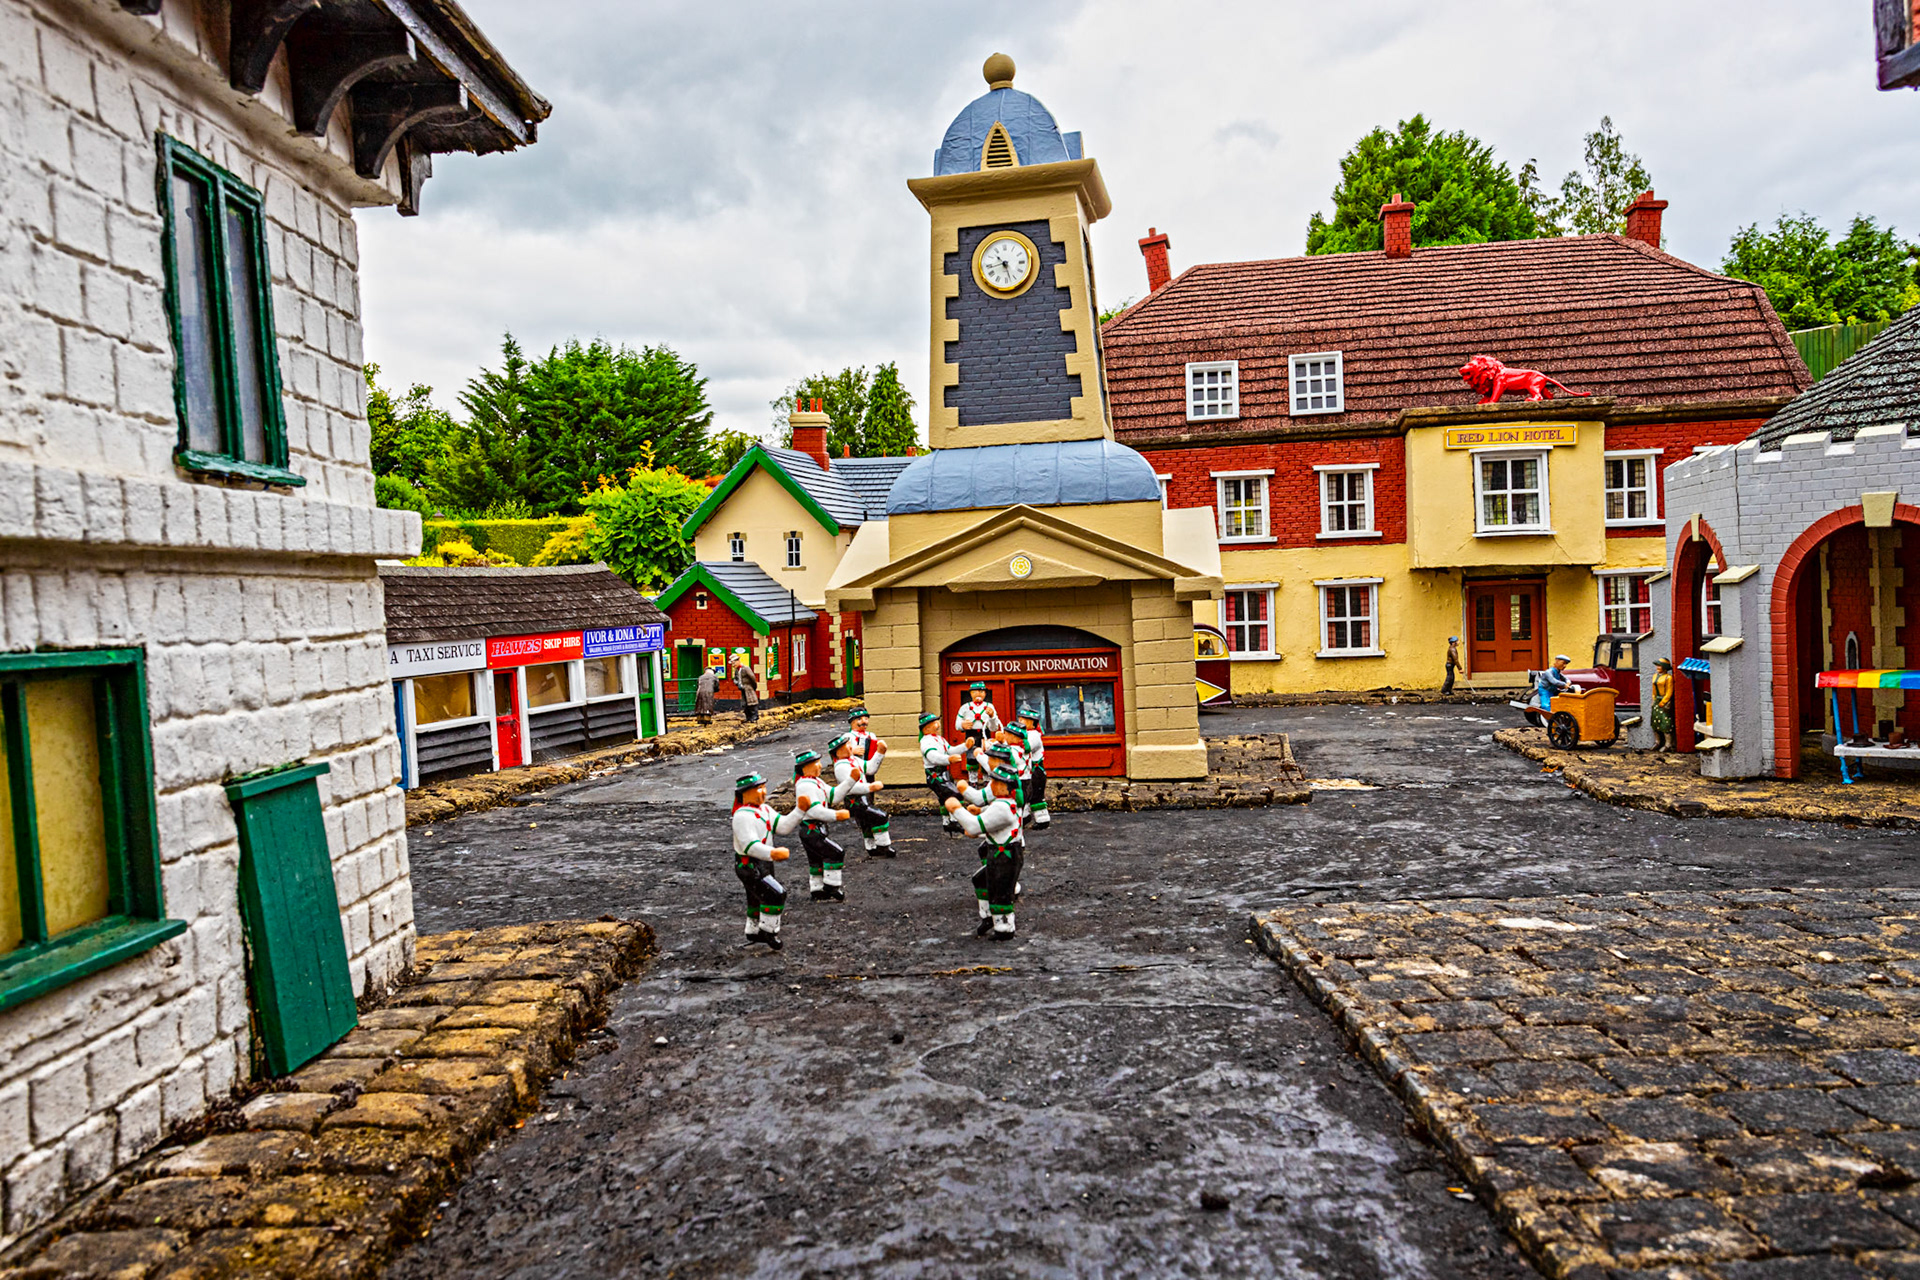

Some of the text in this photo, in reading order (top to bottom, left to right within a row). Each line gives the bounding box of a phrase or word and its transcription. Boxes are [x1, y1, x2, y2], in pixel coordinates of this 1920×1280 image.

[1457, 429, 1565, 444] RED LION HOTEL
[586, 630, 607, 645] IVOR
[607, 629, 615, 642] &
[615, 628, 635, 642] IONA
[636, 626, 661, 640] PLOTT
[406, 647, 434, 663] TAXI
[437, 643, 482, 660] SERVICE
[491, 638, 542, 657] HAWES
[543, 638, 562, 650] SKIP
[563, 636, 581, 648] HIRE
[966, 656, 1109, 673] VISITOR INFORMATION
